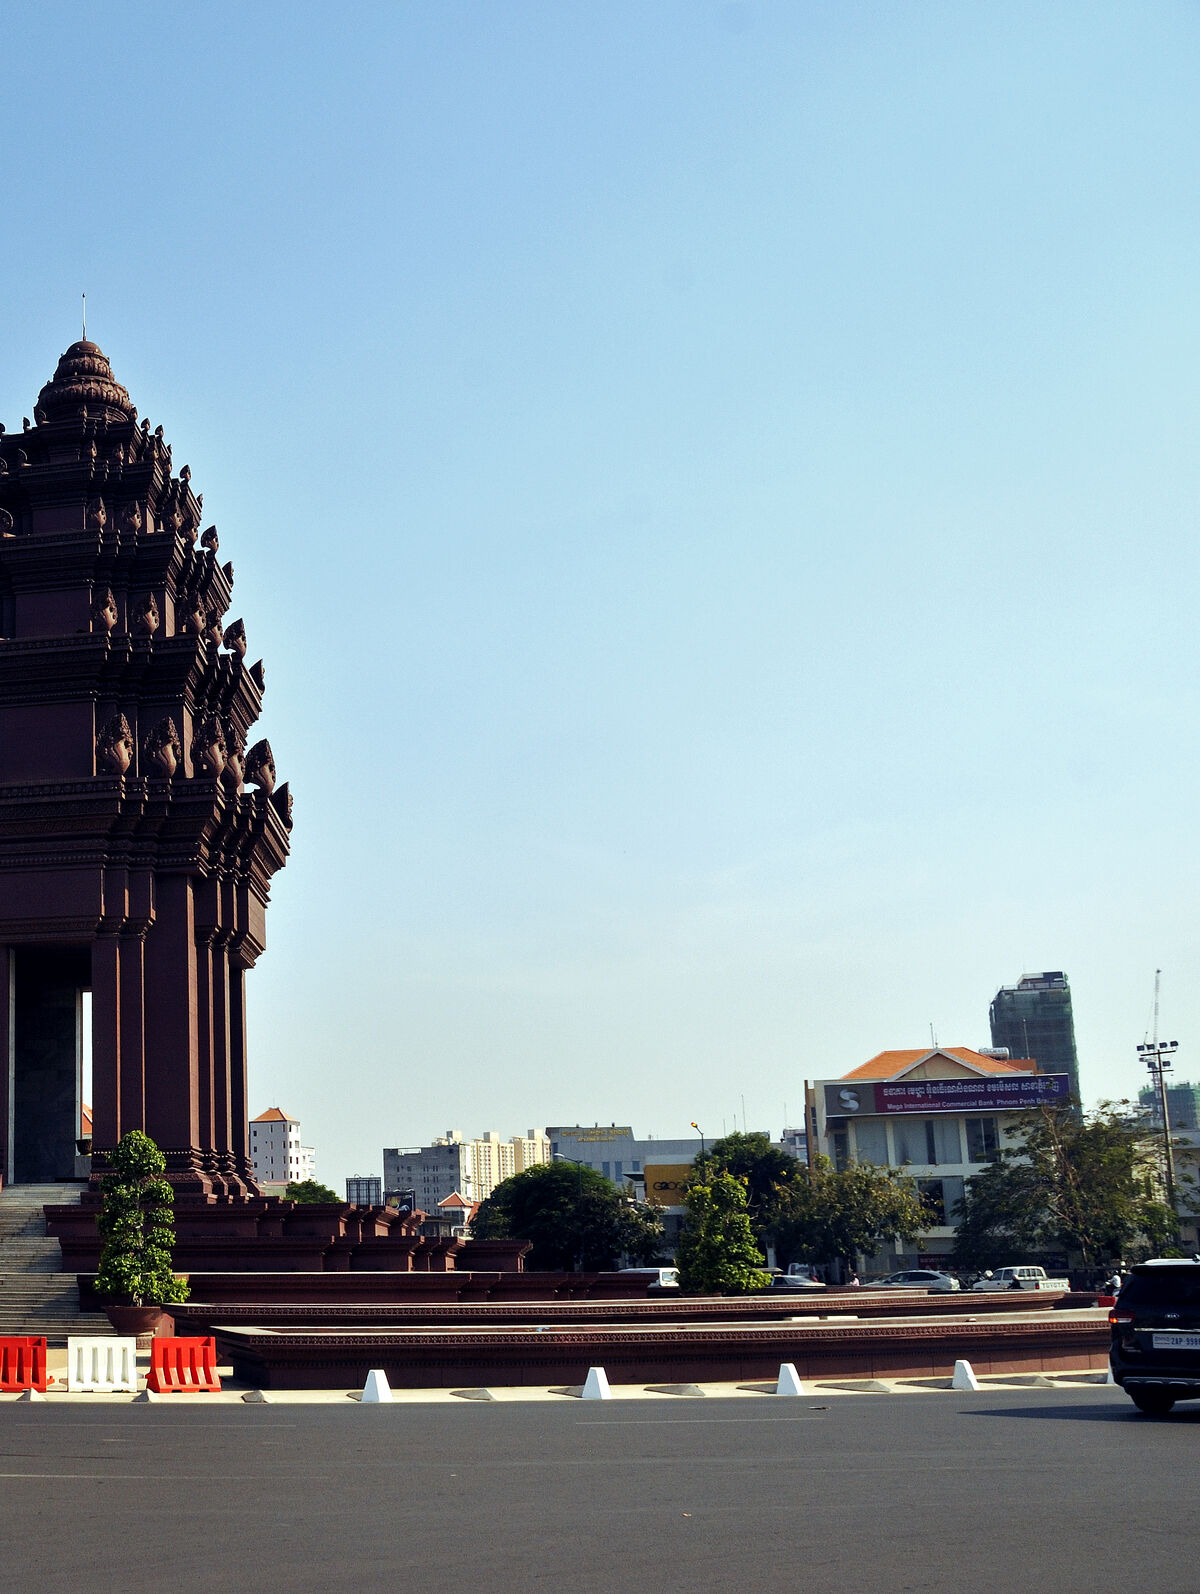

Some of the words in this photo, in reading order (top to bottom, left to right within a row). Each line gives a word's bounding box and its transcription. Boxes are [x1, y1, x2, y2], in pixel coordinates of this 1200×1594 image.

[904, 1101, 940, 1109] International
[941, 1100, 977, 1108] Commercial
[978, 1099, 994, 1107] Bank
[996, 1098, 1019, 1106] Phnom
[1019, 1097, 1035, 1105] Penh
